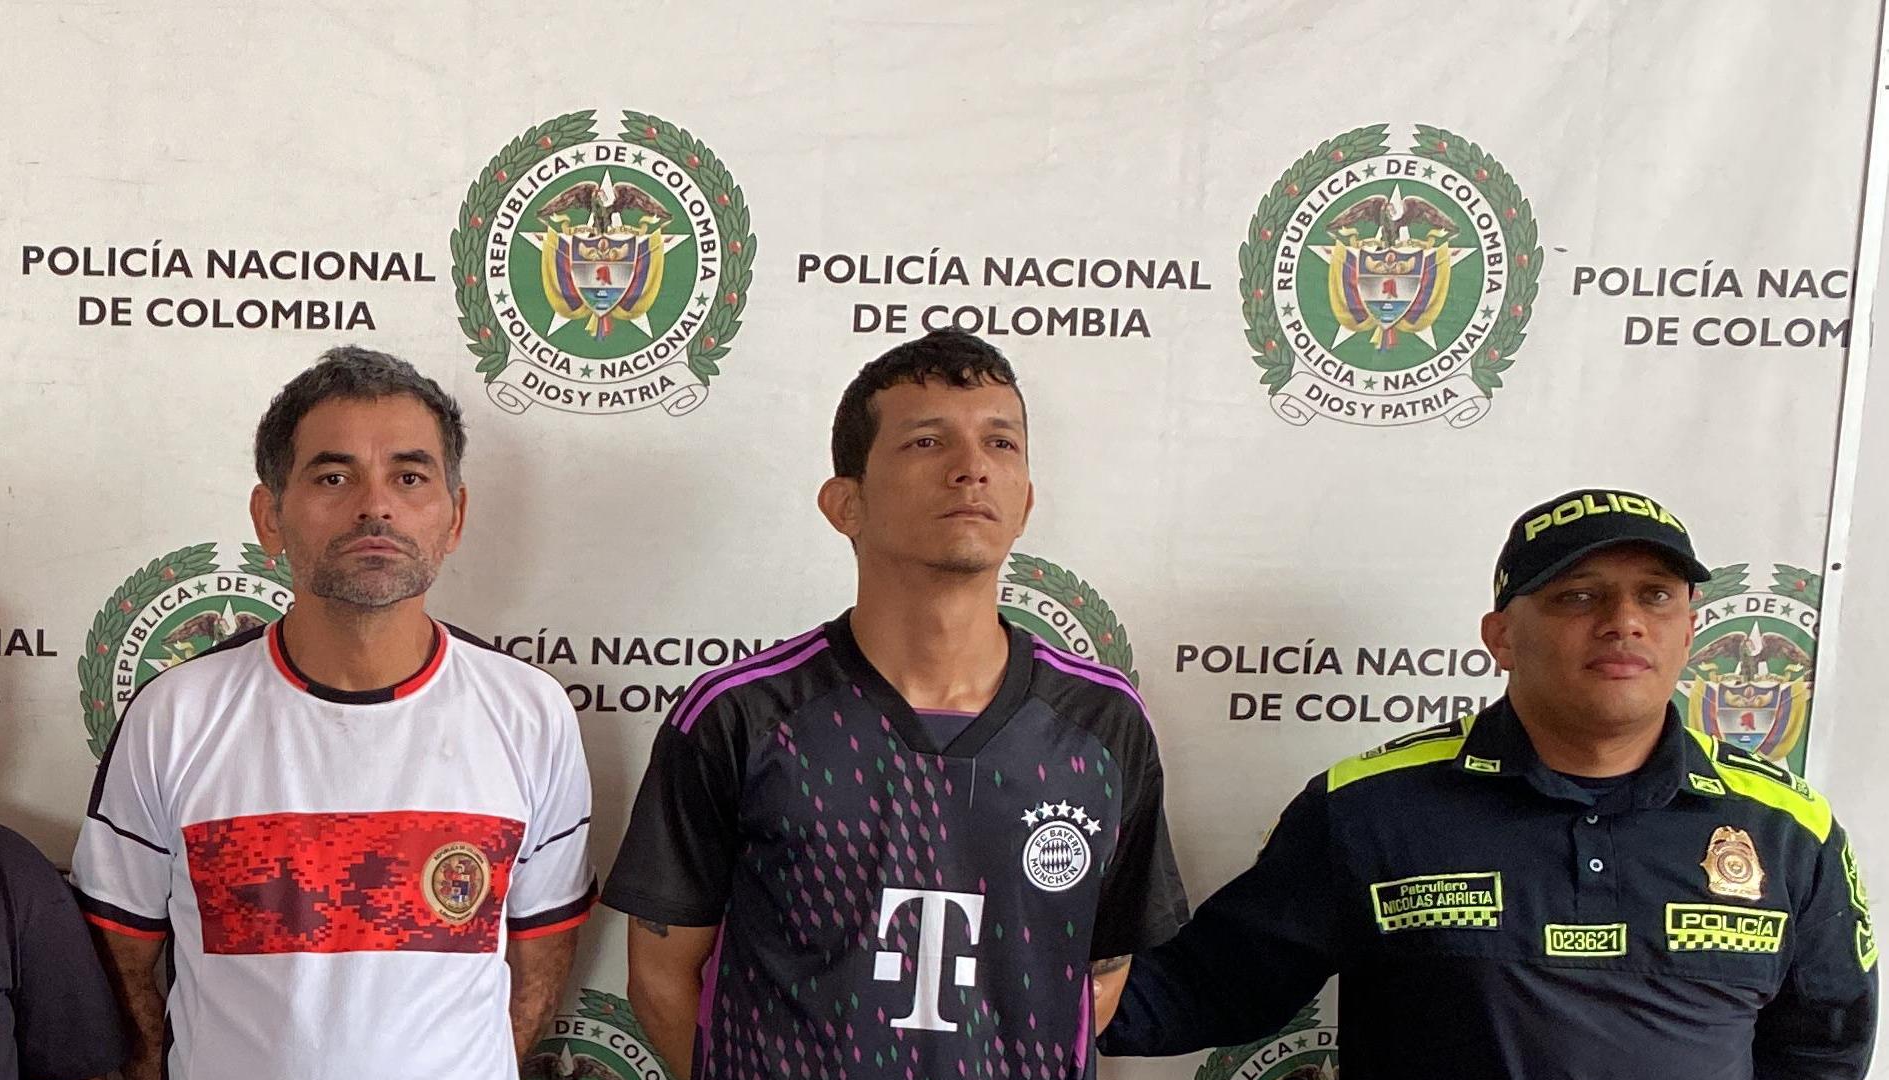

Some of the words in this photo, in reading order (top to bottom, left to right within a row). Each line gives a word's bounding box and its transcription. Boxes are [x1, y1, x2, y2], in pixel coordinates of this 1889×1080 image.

[595, 145, 627, 162] DE
[651, 161, 716, 281] COLOMBIA
[1386, 159, 1417, 176] DE
[1441, 174, 1503, 294] COLOMBIA
[22, 239, 191, 278] POLICÍA
[207, 250, 435, 281] NACIONAL
[798, 248, 969, 285] POLICÍA
[984, 257, 1211, 289] NACIONAL
[1573, 260, 1743, 297] POLICÍA
[79, 297, 131, 326] DE
[147, 298, 375, 330] COLOMBIA
[854, 304, 908, 333] DE
[921, 304, 1151, 338] COLOMBIA
[601, 309, 704, 378] NACIONAL
[1625, 317, 1679, 345] DE
[1692, 317, 1851, 348] COLOM
[1383, 322, 1489, 391] NACIONAL
[522, 372, 574, 405] DIOS
[576, 391, 592, 407] Y
[599, 375, 675, 408] PATRIA
[1305, 384, 1356, 415] DIOS
[1359, 403, 1374, 419] Y
[1381, 387, 1458, 419] PATRIA
[1525, 492, 1686, 541] POLICÍA
[217, 576, 248, 593] DE
[1745, 597, 1777, 614] DE
[1037, 600, 1091, 655] COLO
[591, 636, 772, 666] NACION
[1176, 639, 1342, 675] POLICÍA
[1356, 647, 1502, 678] NACIO
[564, 684, 685, 712] OLOM
[1229, 693, 1281, 721] DE
[1035, 833, 1048, 848] FC
[1050, 829, 1082, 856] BAYERN
[1437, 890, 1494, 907] ARRIETA
[1552, 930, 1618, 951] 023621
[1681, 912, 1774, 937] POLICÍA
[555, 1020, 586, 1036] DE
